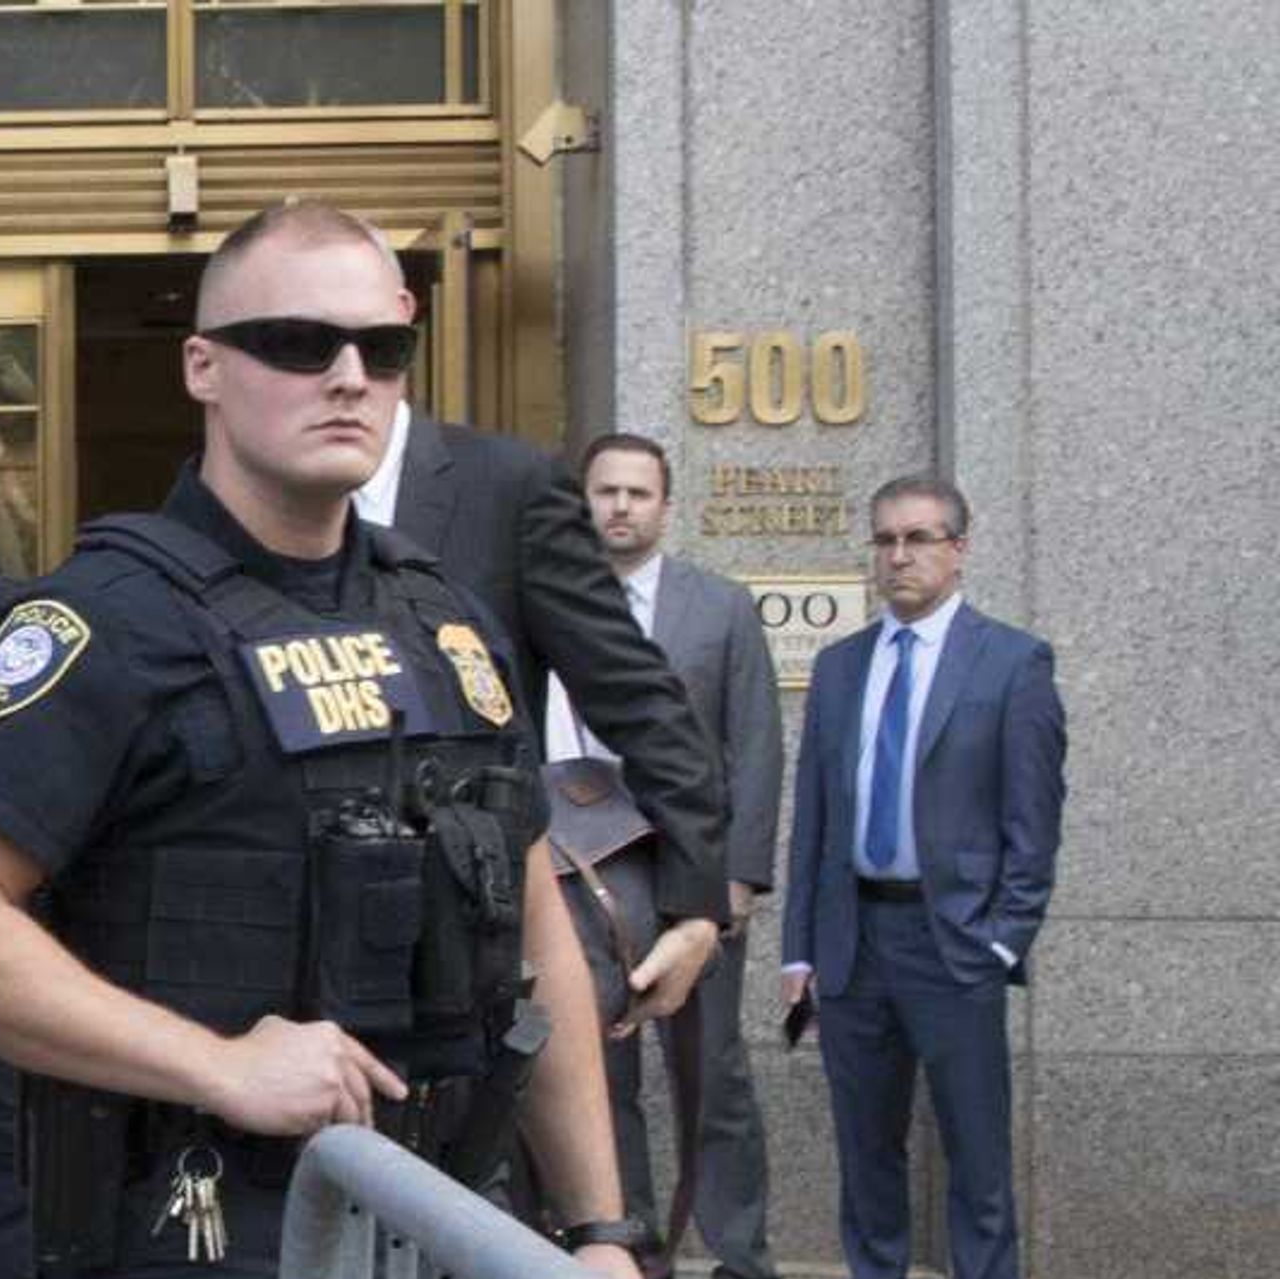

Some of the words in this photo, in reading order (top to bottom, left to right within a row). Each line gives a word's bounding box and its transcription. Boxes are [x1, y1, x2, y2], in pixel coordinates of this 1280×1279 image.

[689, 329, 864, 425] 500
[255, 633, 403, 693] POLICE
[306, 679, 392, 734] DHS
